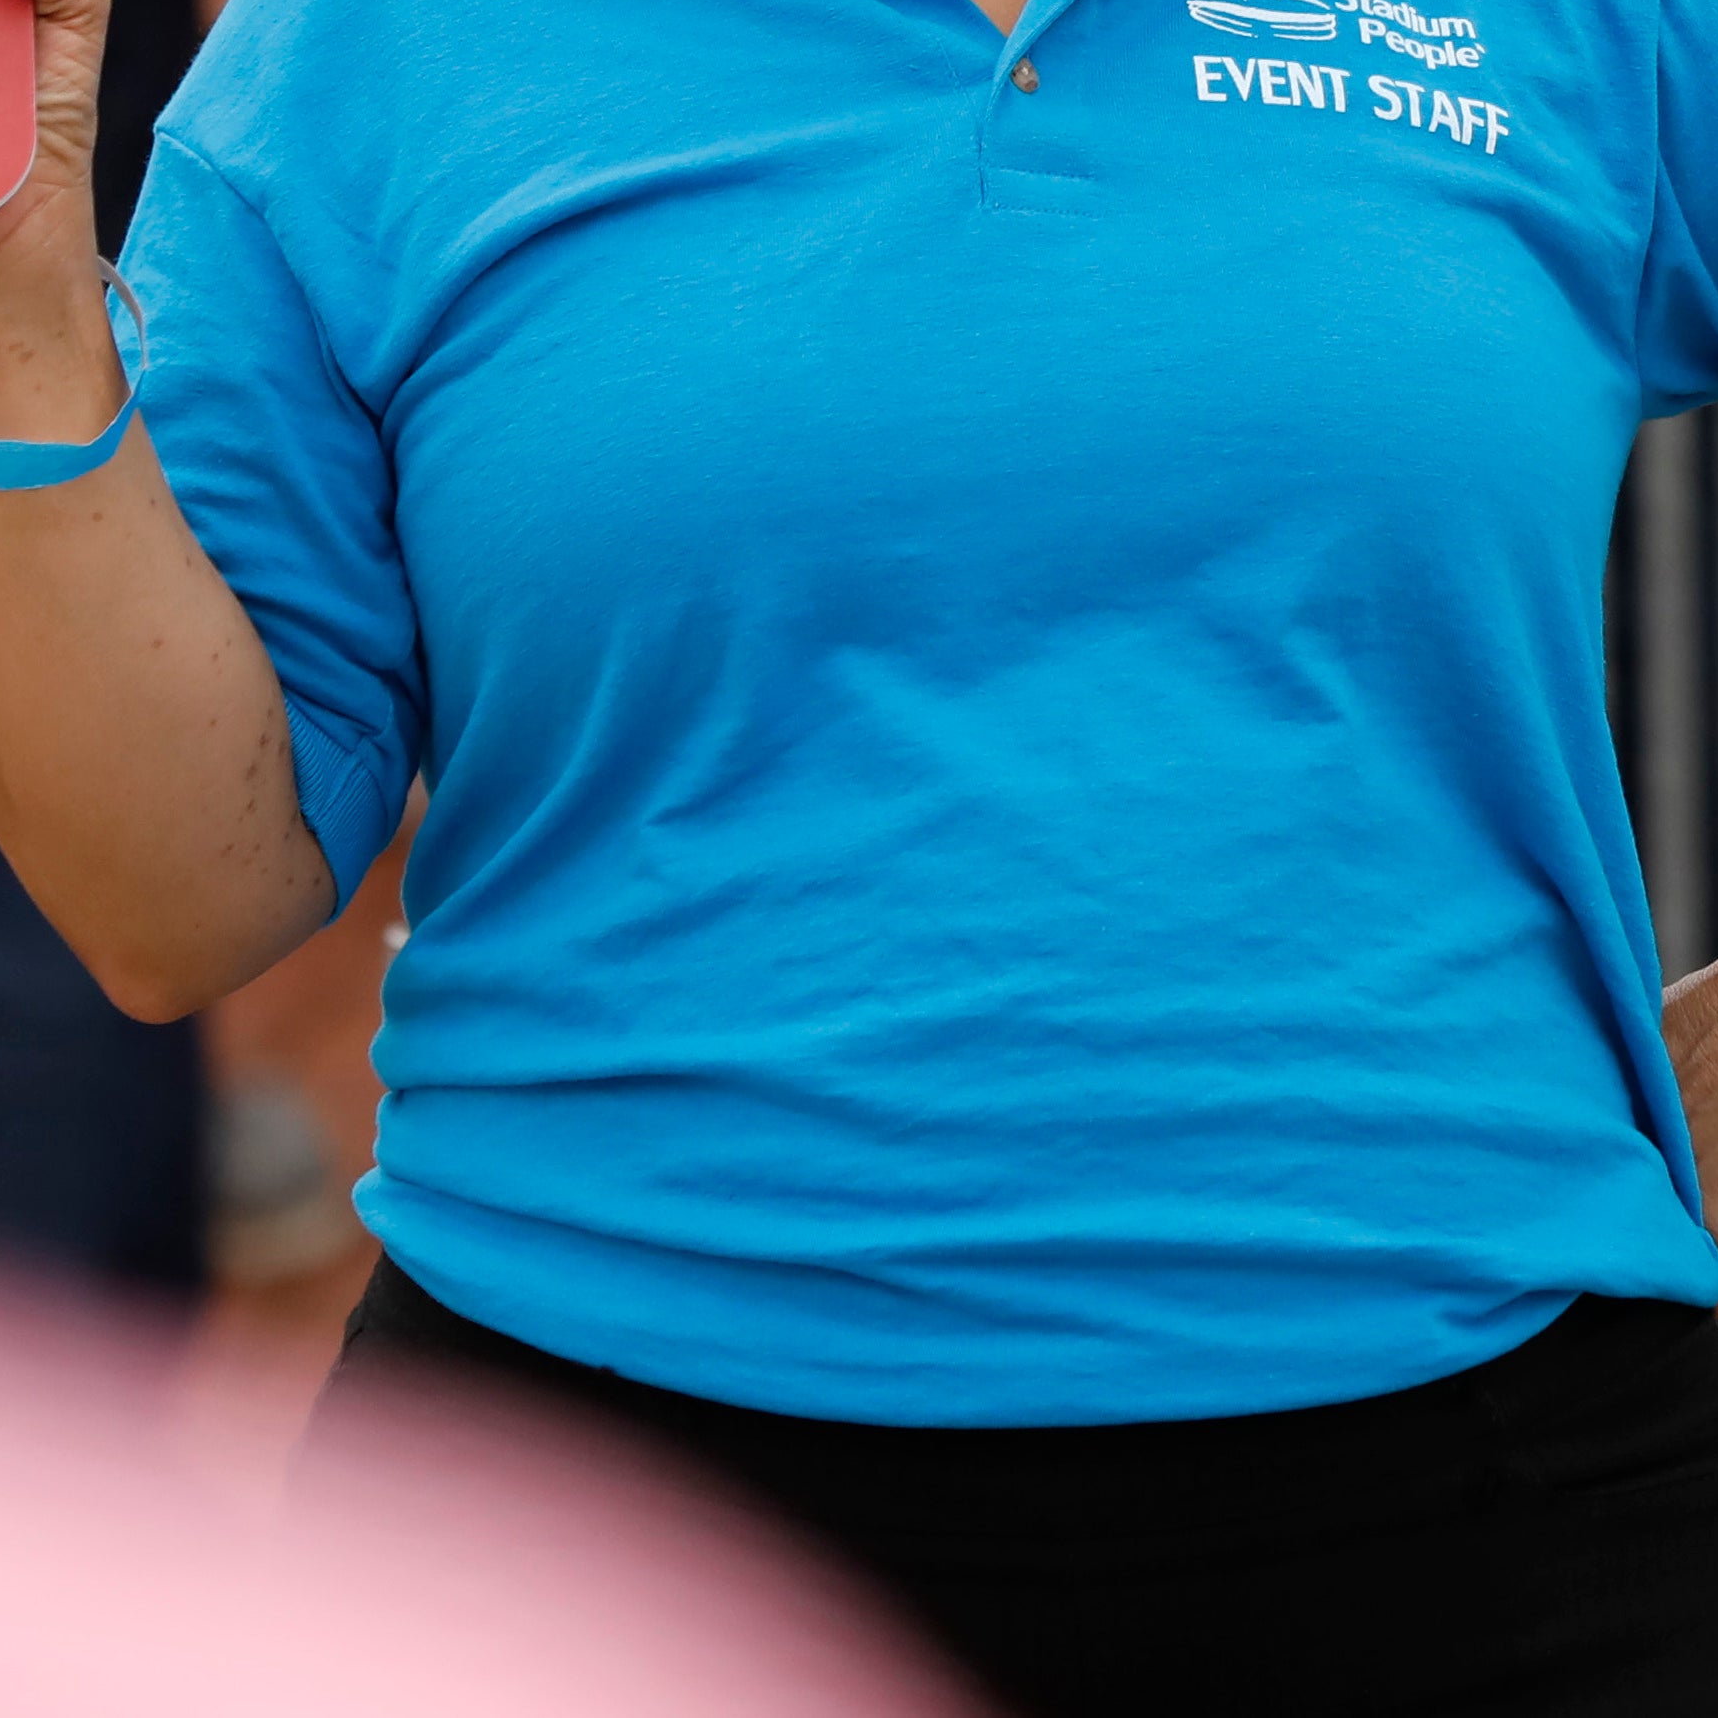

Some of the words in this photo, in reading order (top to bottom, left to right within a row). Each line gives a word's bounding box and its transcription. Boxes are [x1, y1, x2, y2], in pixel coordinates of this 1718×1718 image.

[1358, 17, 1480, 70] People
[1193, 55, 1350, 113] EVENT
[1368, 74, 1509, 155] STAFF
